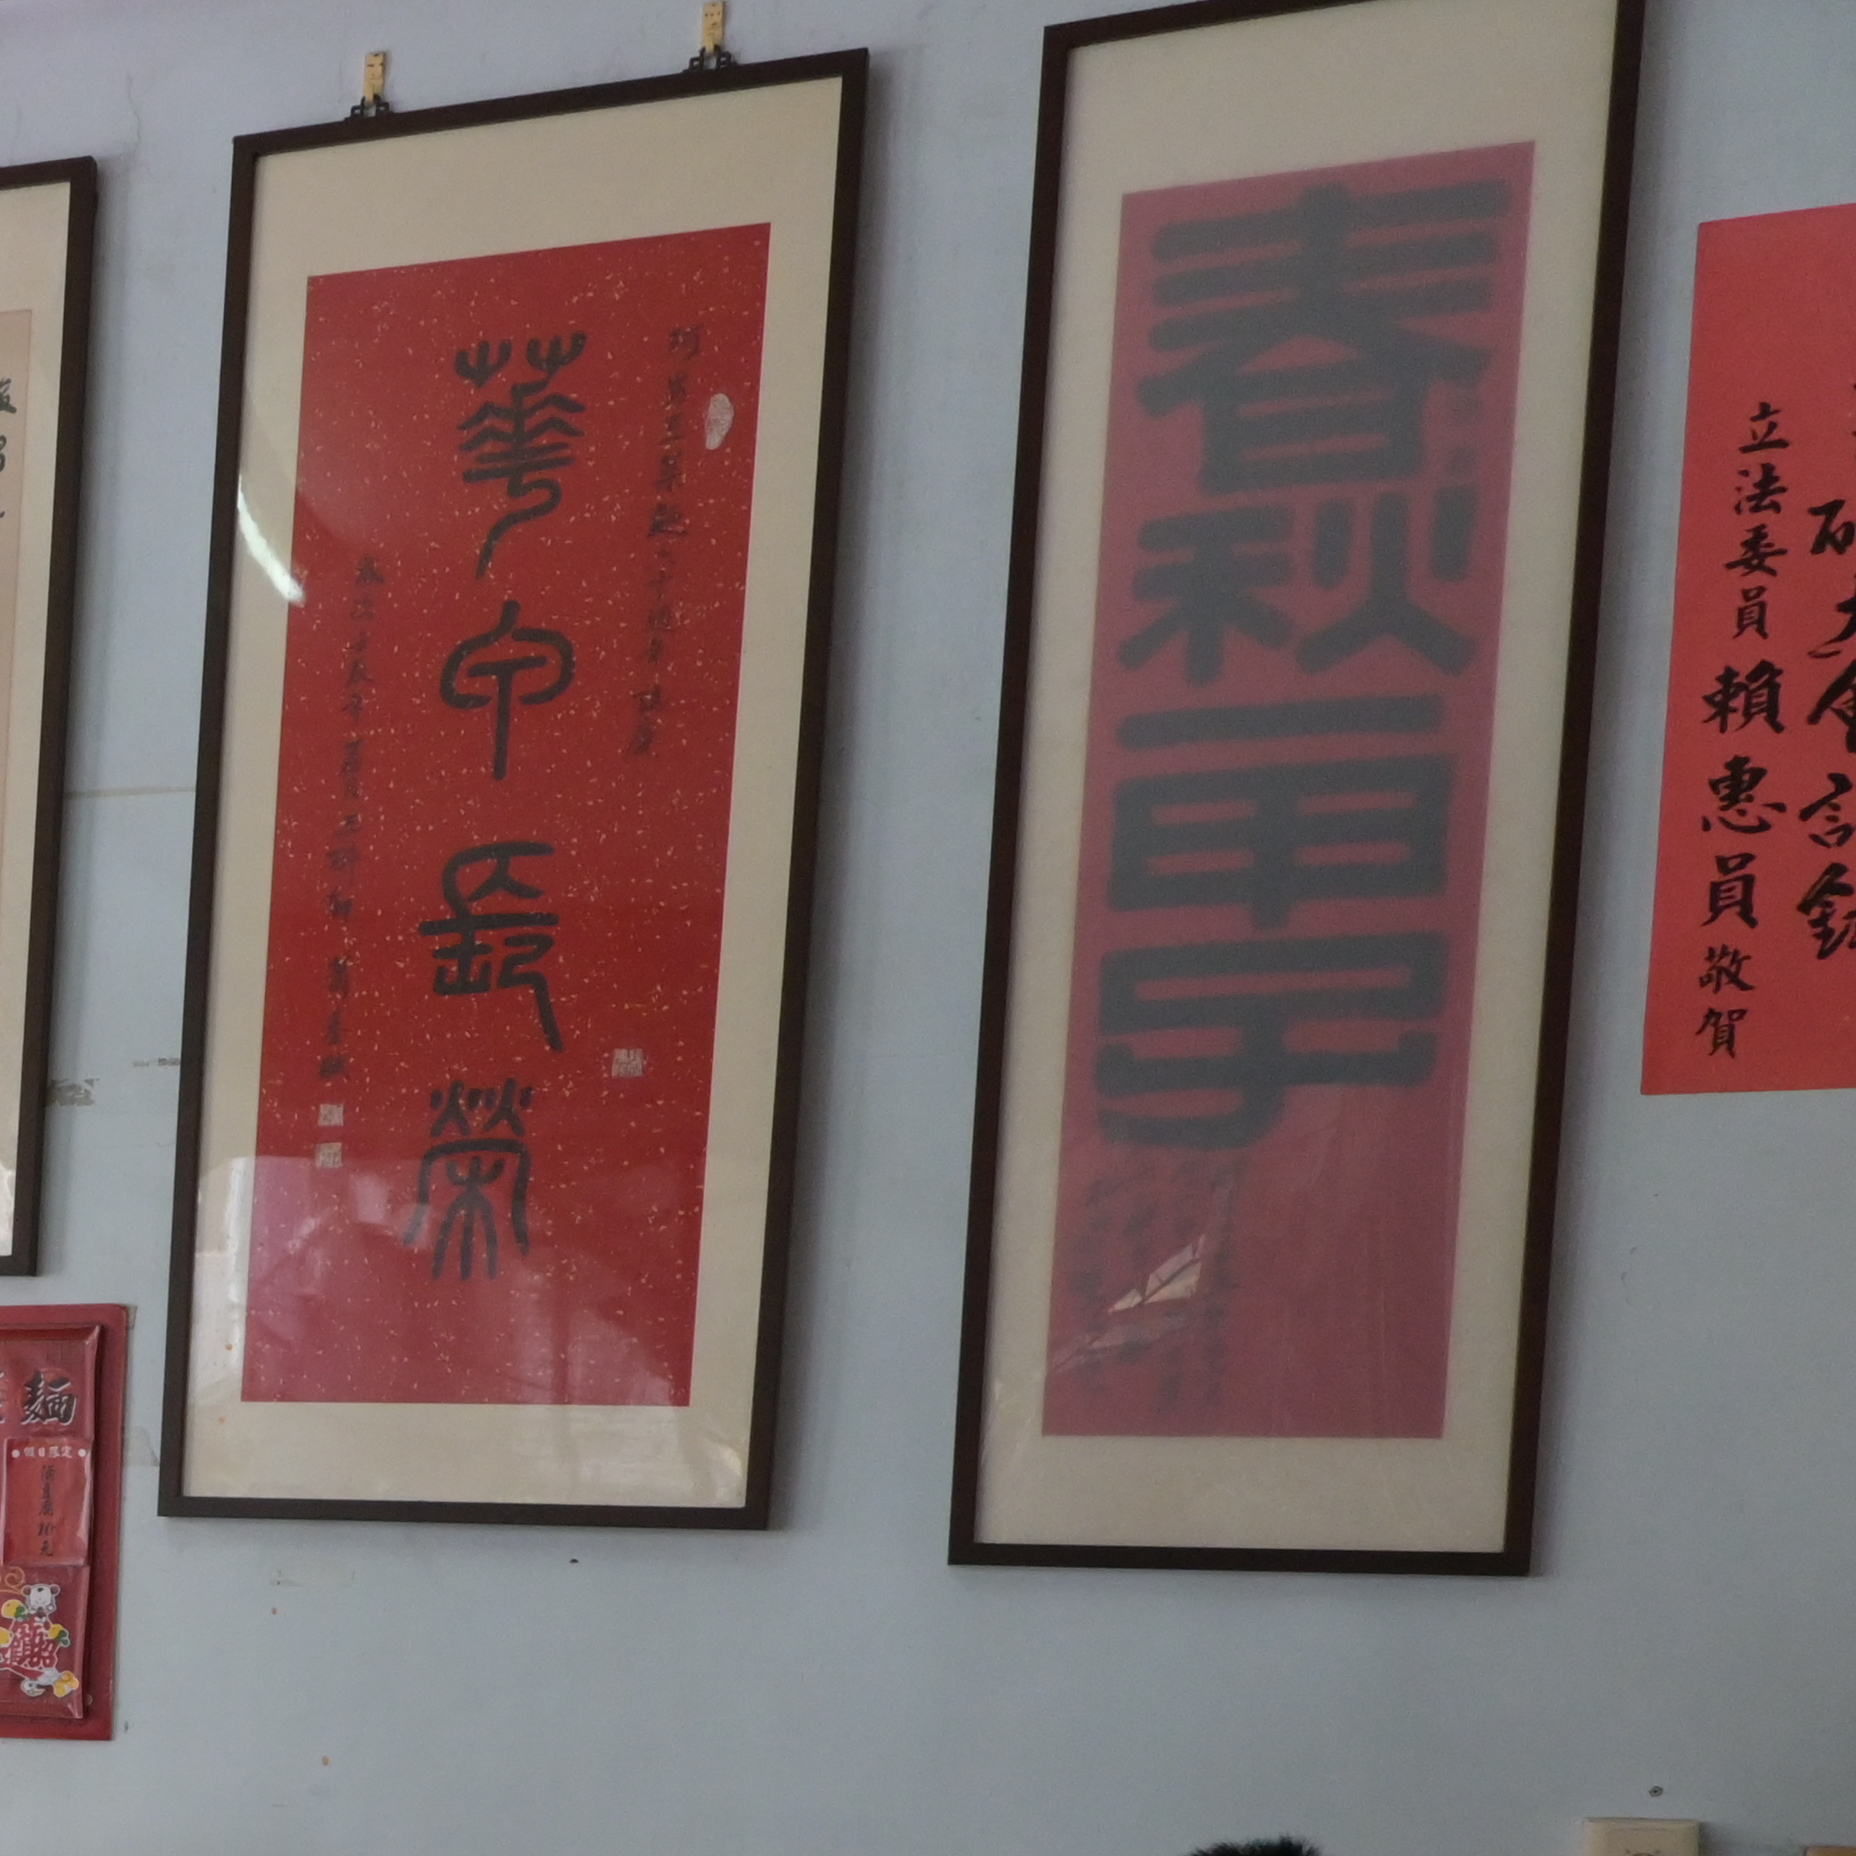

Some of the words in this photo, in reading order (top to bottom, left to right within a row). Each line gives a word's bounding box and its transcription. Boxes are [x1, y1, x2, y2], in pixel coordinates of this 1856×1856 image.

[1694, 401, 1791, 1060] 立法委員賴惠員敬賀
